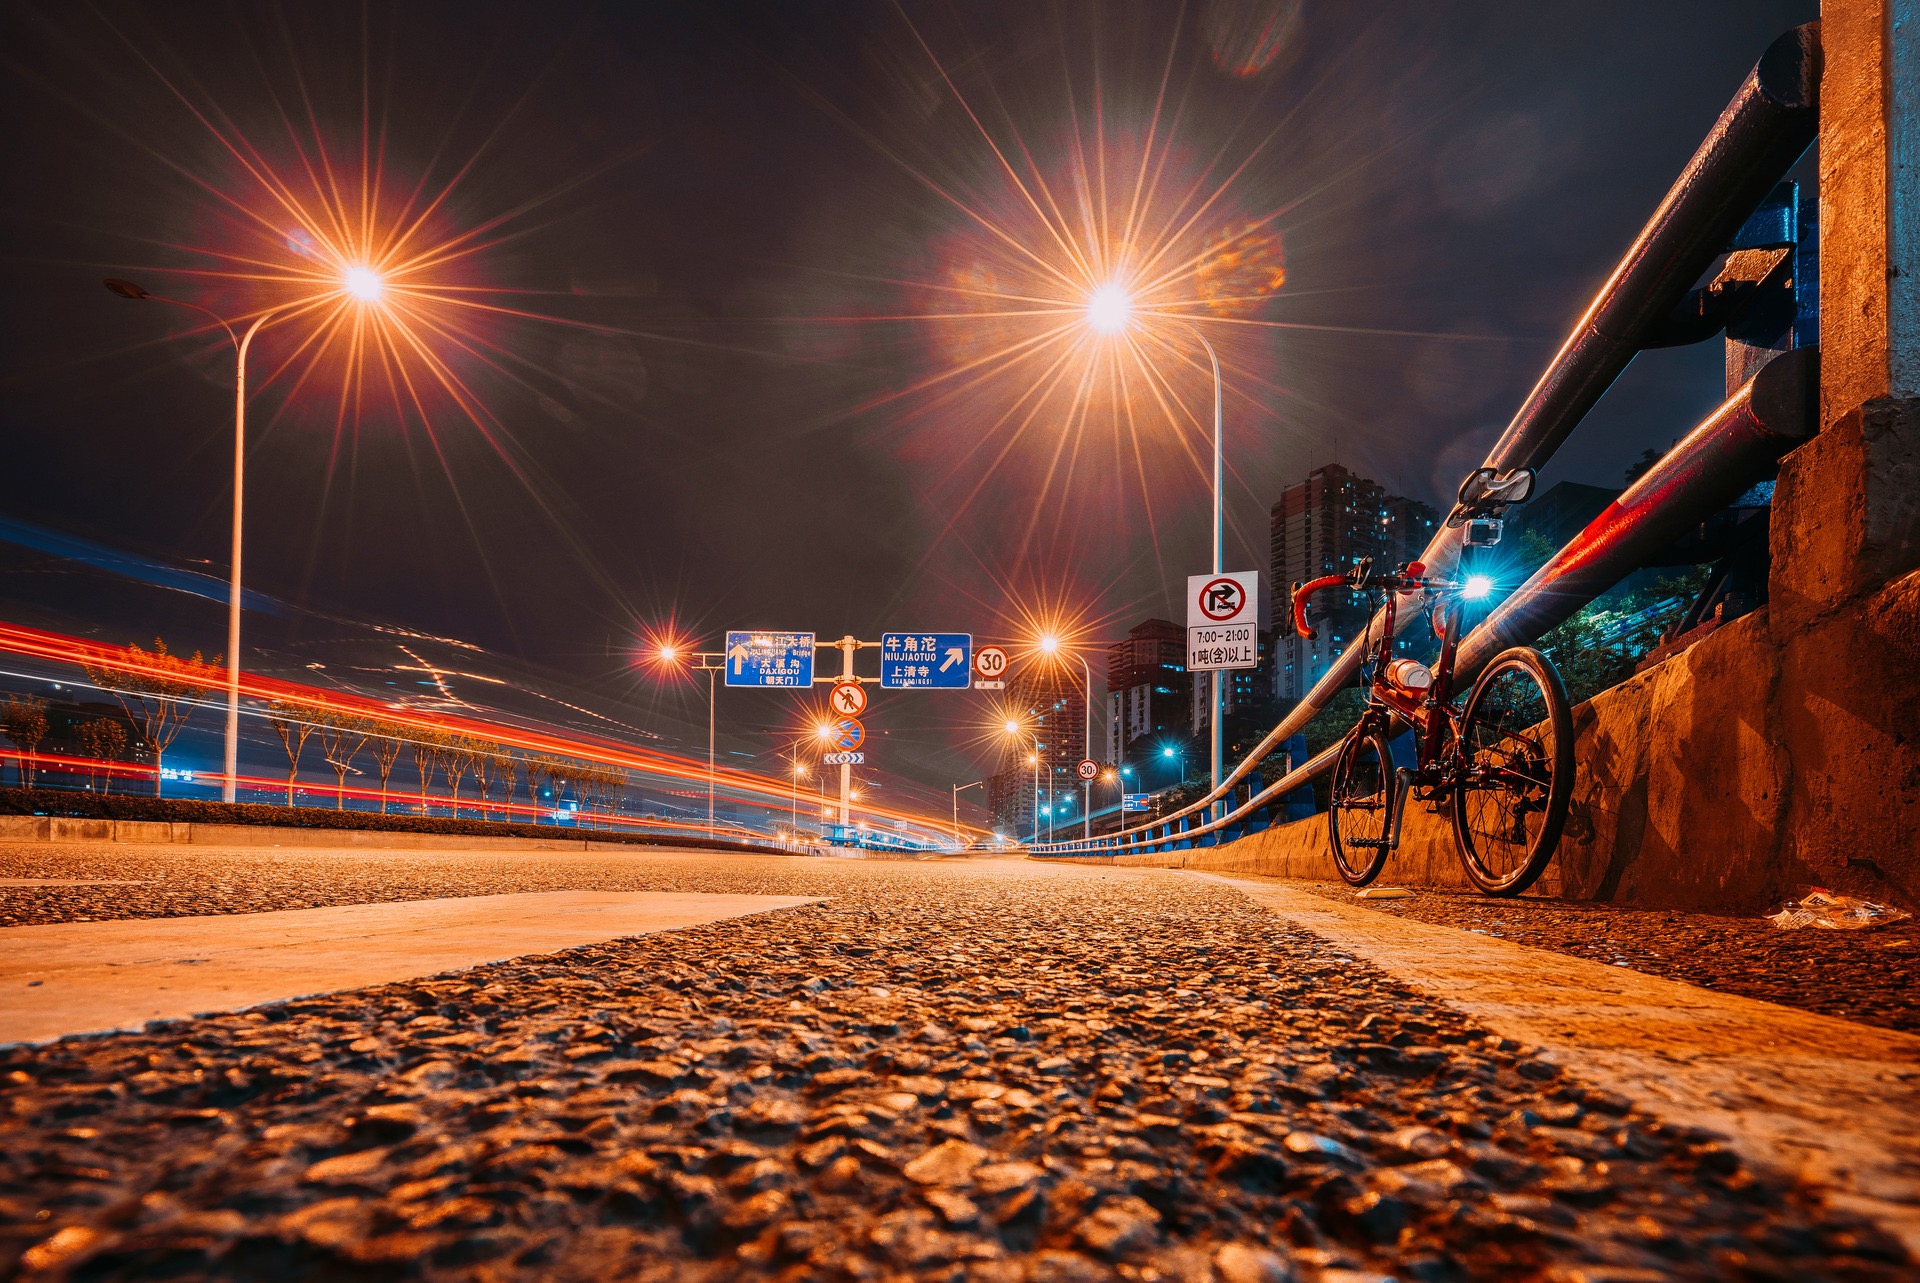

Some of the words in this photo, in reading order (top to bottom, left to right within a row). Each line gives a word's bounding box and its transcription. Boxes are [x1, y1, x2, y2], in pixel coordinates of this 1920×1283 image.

[750, 635, 811, 648] 江大桥
[885, 636, 937, 652] 牛角沱
[761, 658, 800, 668] 大溪沟
[884, 652, 937, 662] NIUJIAOTUO
[982, 653, 1003, 671] 30
[891, 665, 930, 678] 上清寺
